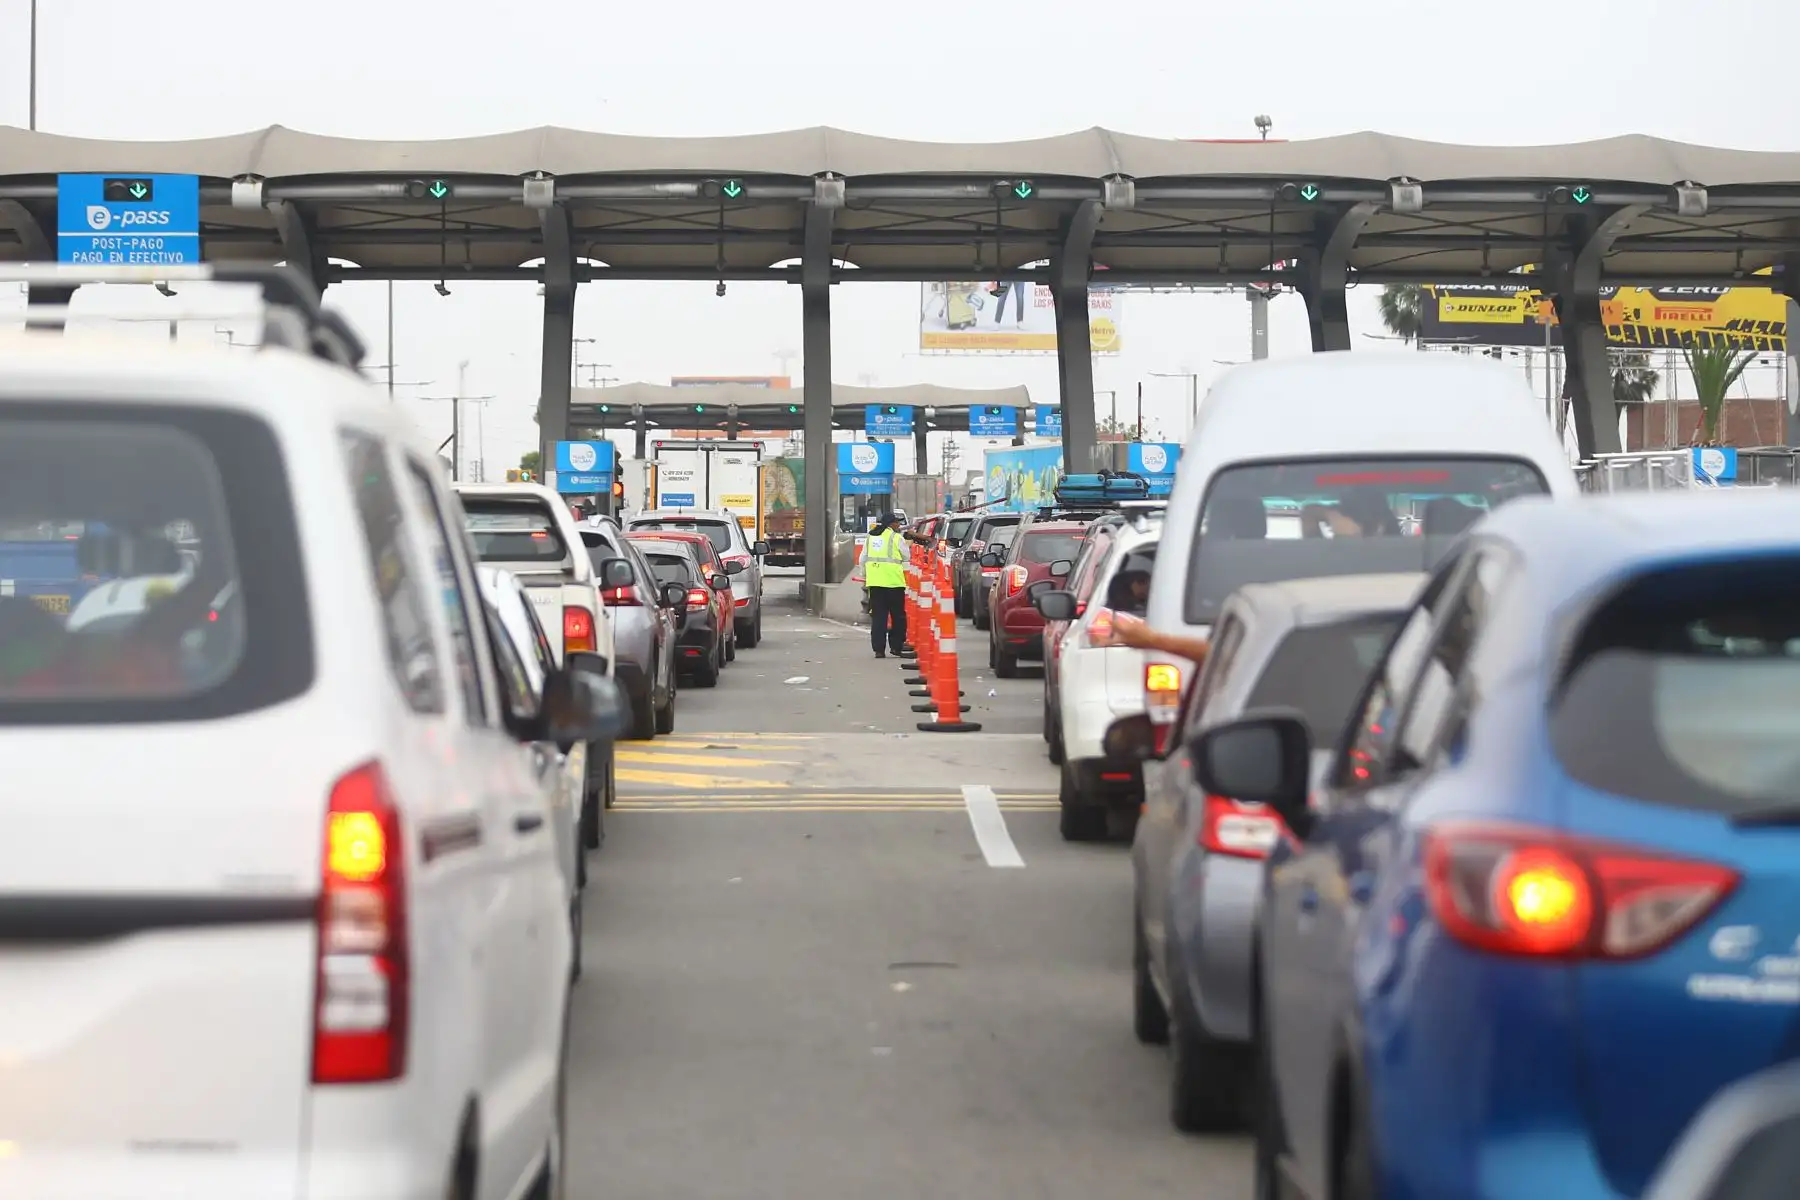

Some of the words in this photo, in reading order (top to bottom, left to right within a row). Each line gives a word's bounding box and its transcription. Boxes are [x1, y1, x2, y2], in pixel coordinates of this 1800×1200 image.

[87, 206, 170, 228] e-pass
[92, 238, 164, 250] POST-PAGO
[72, 251, 104, 263] PAGO
[109, 252, 124, 263] EN
[129, 252, 184, 264] EFECTIVO
[1034, 299, 1046, 308] LOS
[1091, 299, 1112, 309] BAJOS
[1457, 304, 1517, 313] DUNLOP
[1654, 306, 1713, 322] PIRELLI
